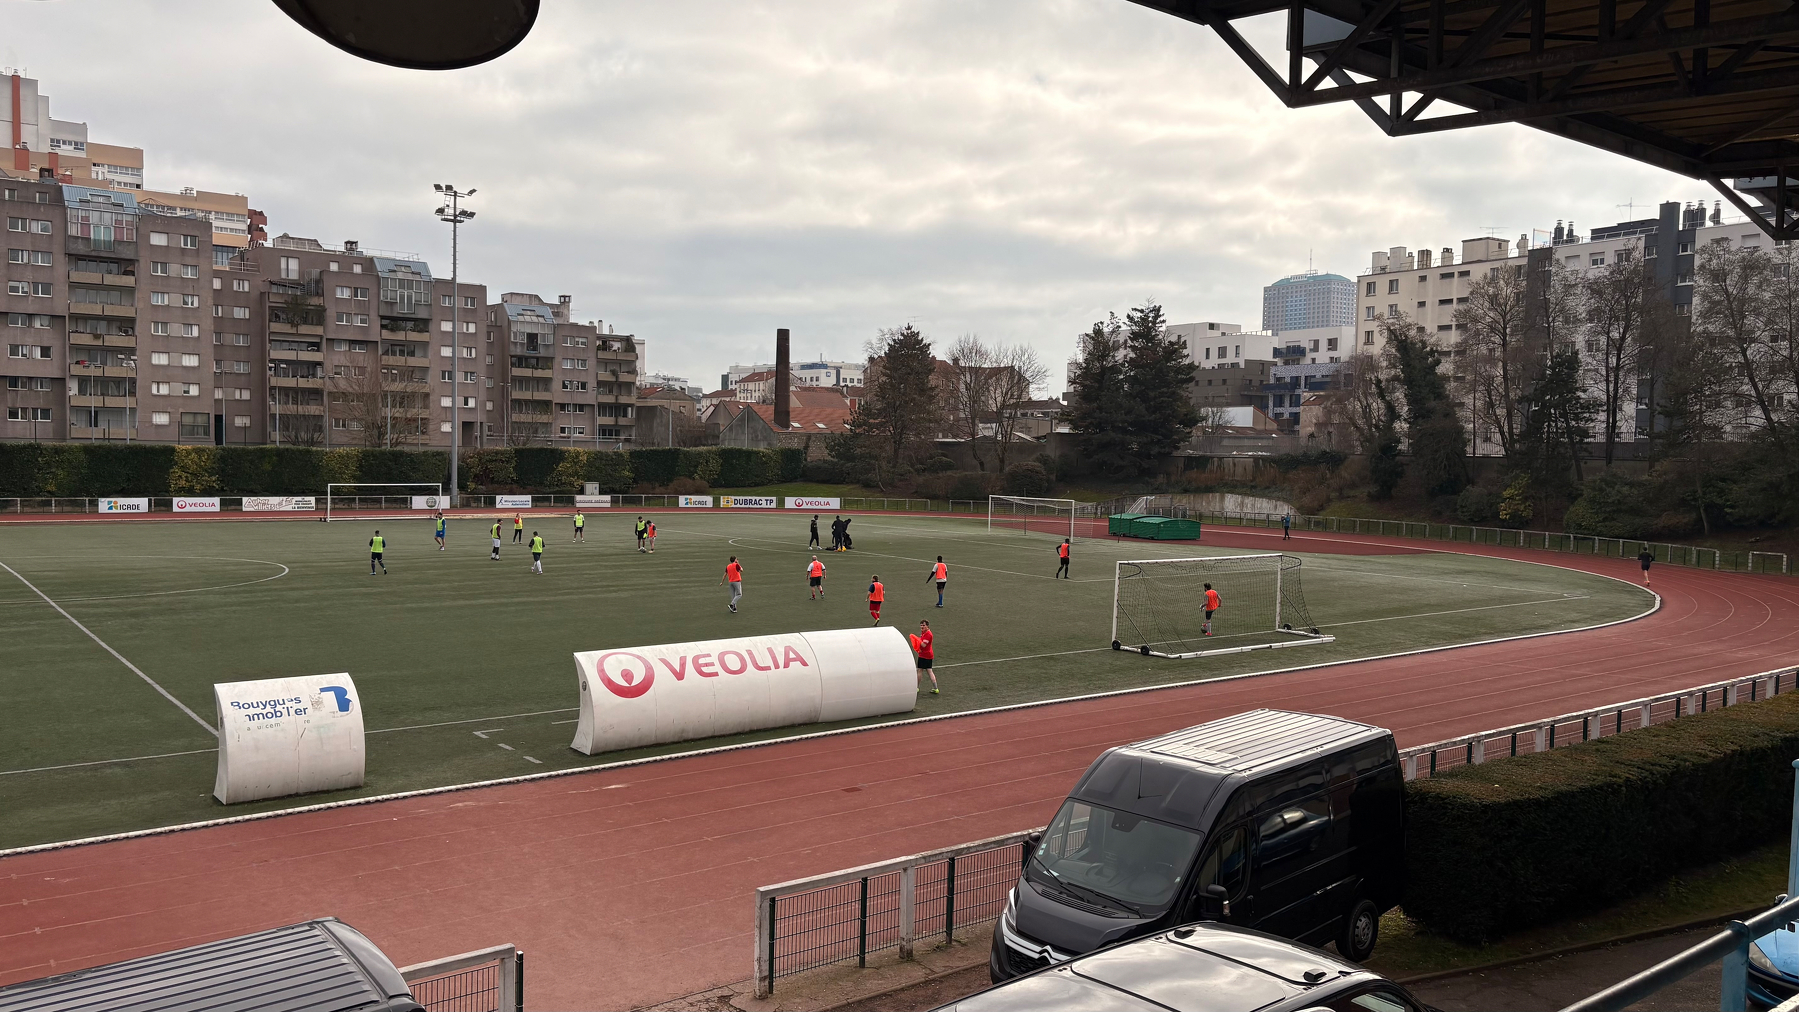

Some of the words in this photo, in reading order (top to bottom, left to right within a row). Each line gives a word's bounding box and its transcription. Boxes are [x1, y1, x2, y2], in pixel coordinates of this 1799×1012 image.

[734, 498, 763, 506] DUBRAC
[119, 503, 141, 511] ICADE
[658, 645, 809, 682] VEOLIA
